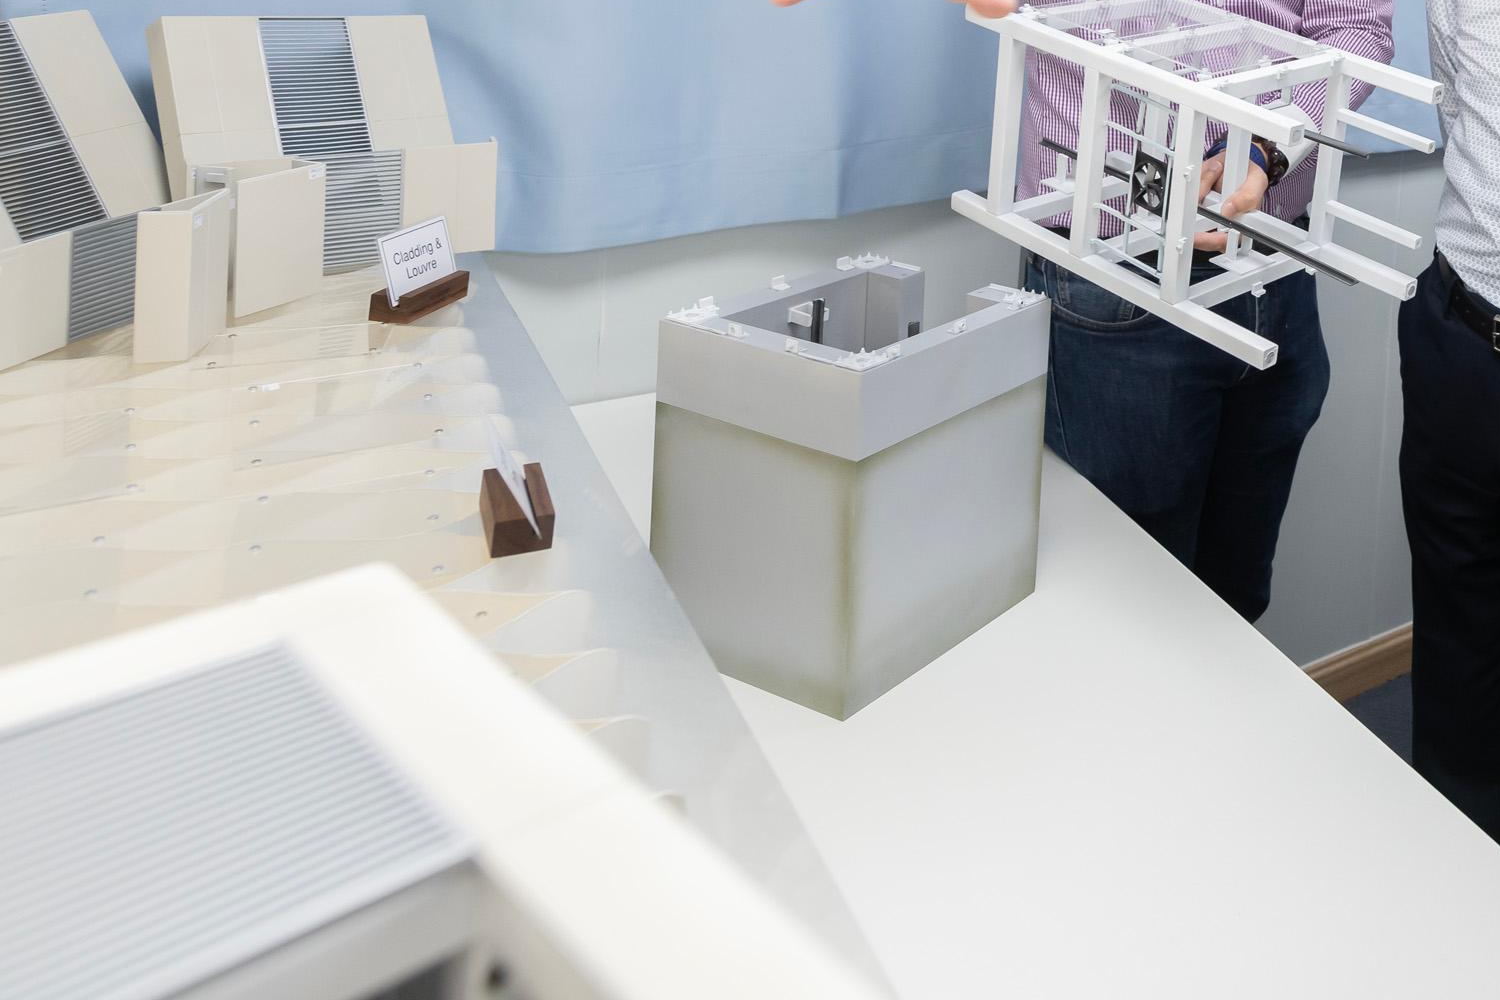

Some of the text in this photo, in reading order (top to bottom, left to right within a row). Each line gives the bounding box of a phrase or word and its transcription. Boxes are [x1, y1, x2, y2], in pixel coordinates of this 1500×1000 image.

[393, 237, 442, 265] Cladding &
[406, 260, 437, 279] Louvre
